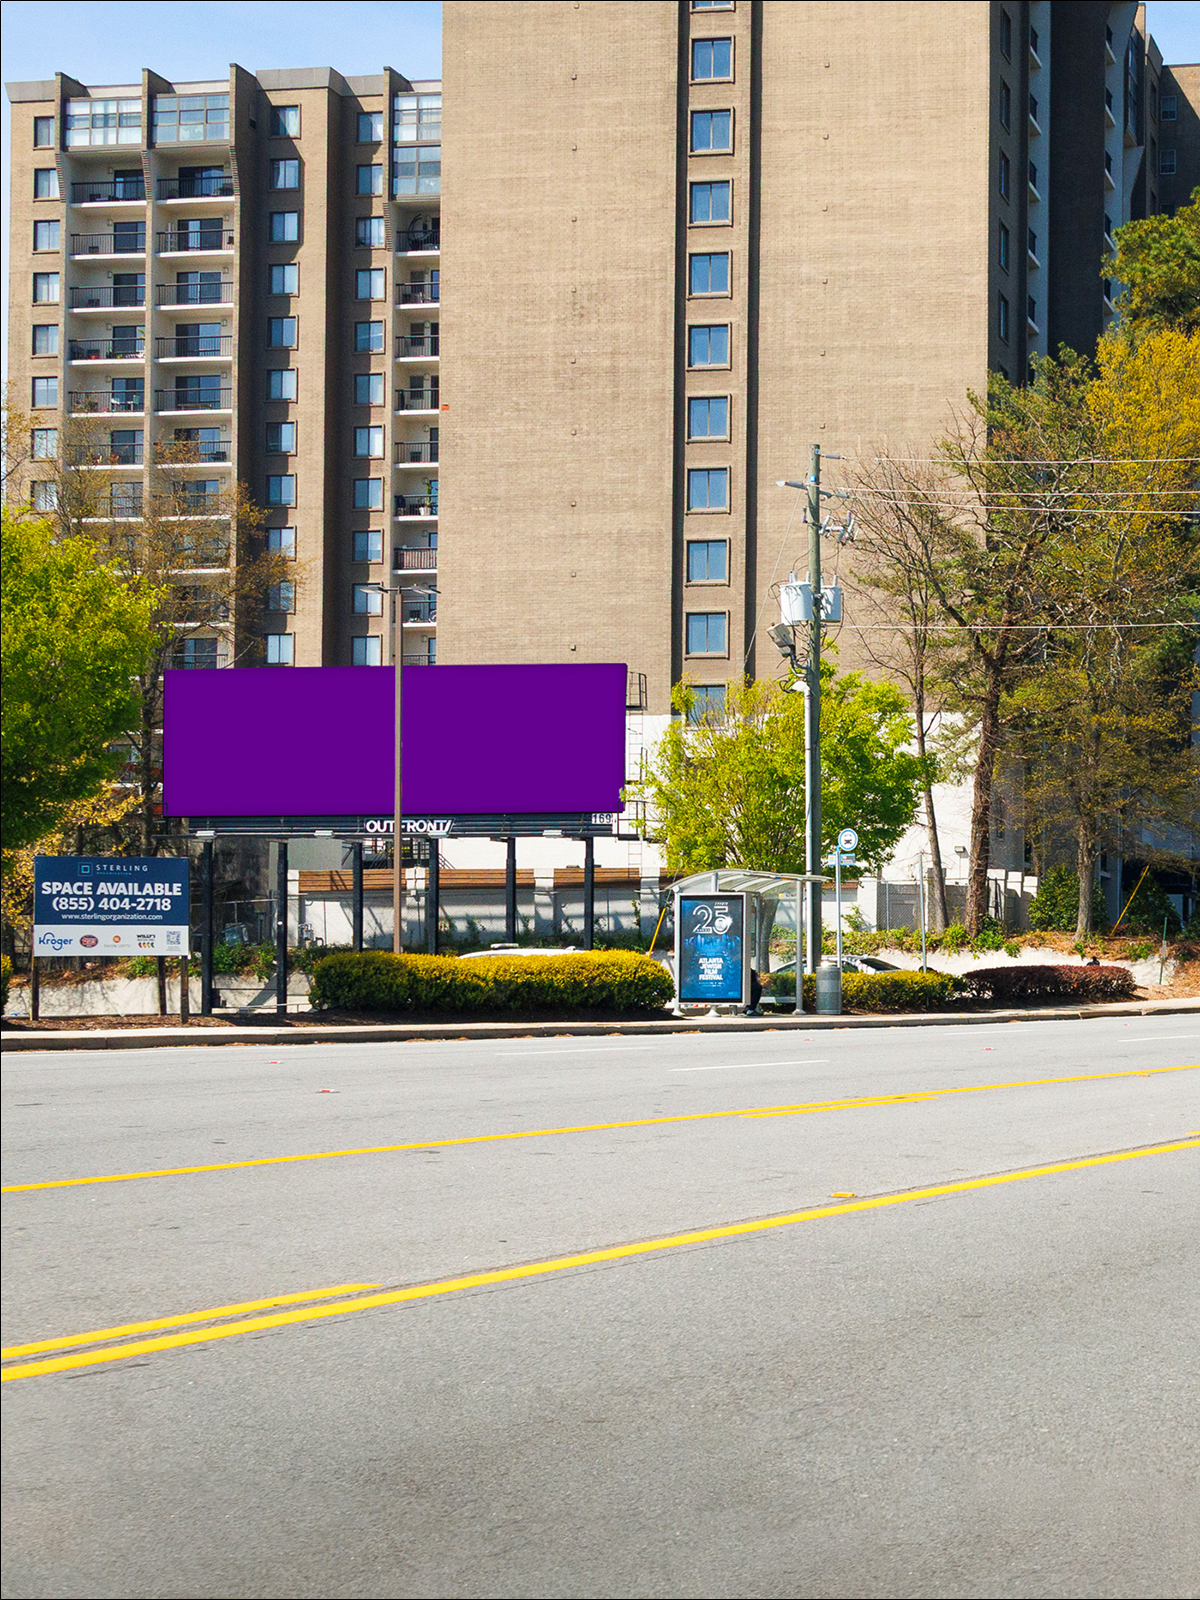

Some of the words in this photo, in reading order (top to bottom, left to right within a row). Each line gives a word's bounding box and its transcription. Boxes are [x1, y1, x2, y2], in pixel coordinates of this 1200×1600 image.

[593, 814, 612, 824] 169
[95, 864, 148, 872] STERLING
[41, 881, 93, 895] SPACE
[96, 882, 182, 896] AVAILABLE
[52, 897, 95, 911] (855)
[98, 898, 171, 911] 404-2718
[61, 913, 163, 921] www.sterlingorganization.com
[38, 932, 73, 951] Kroger
